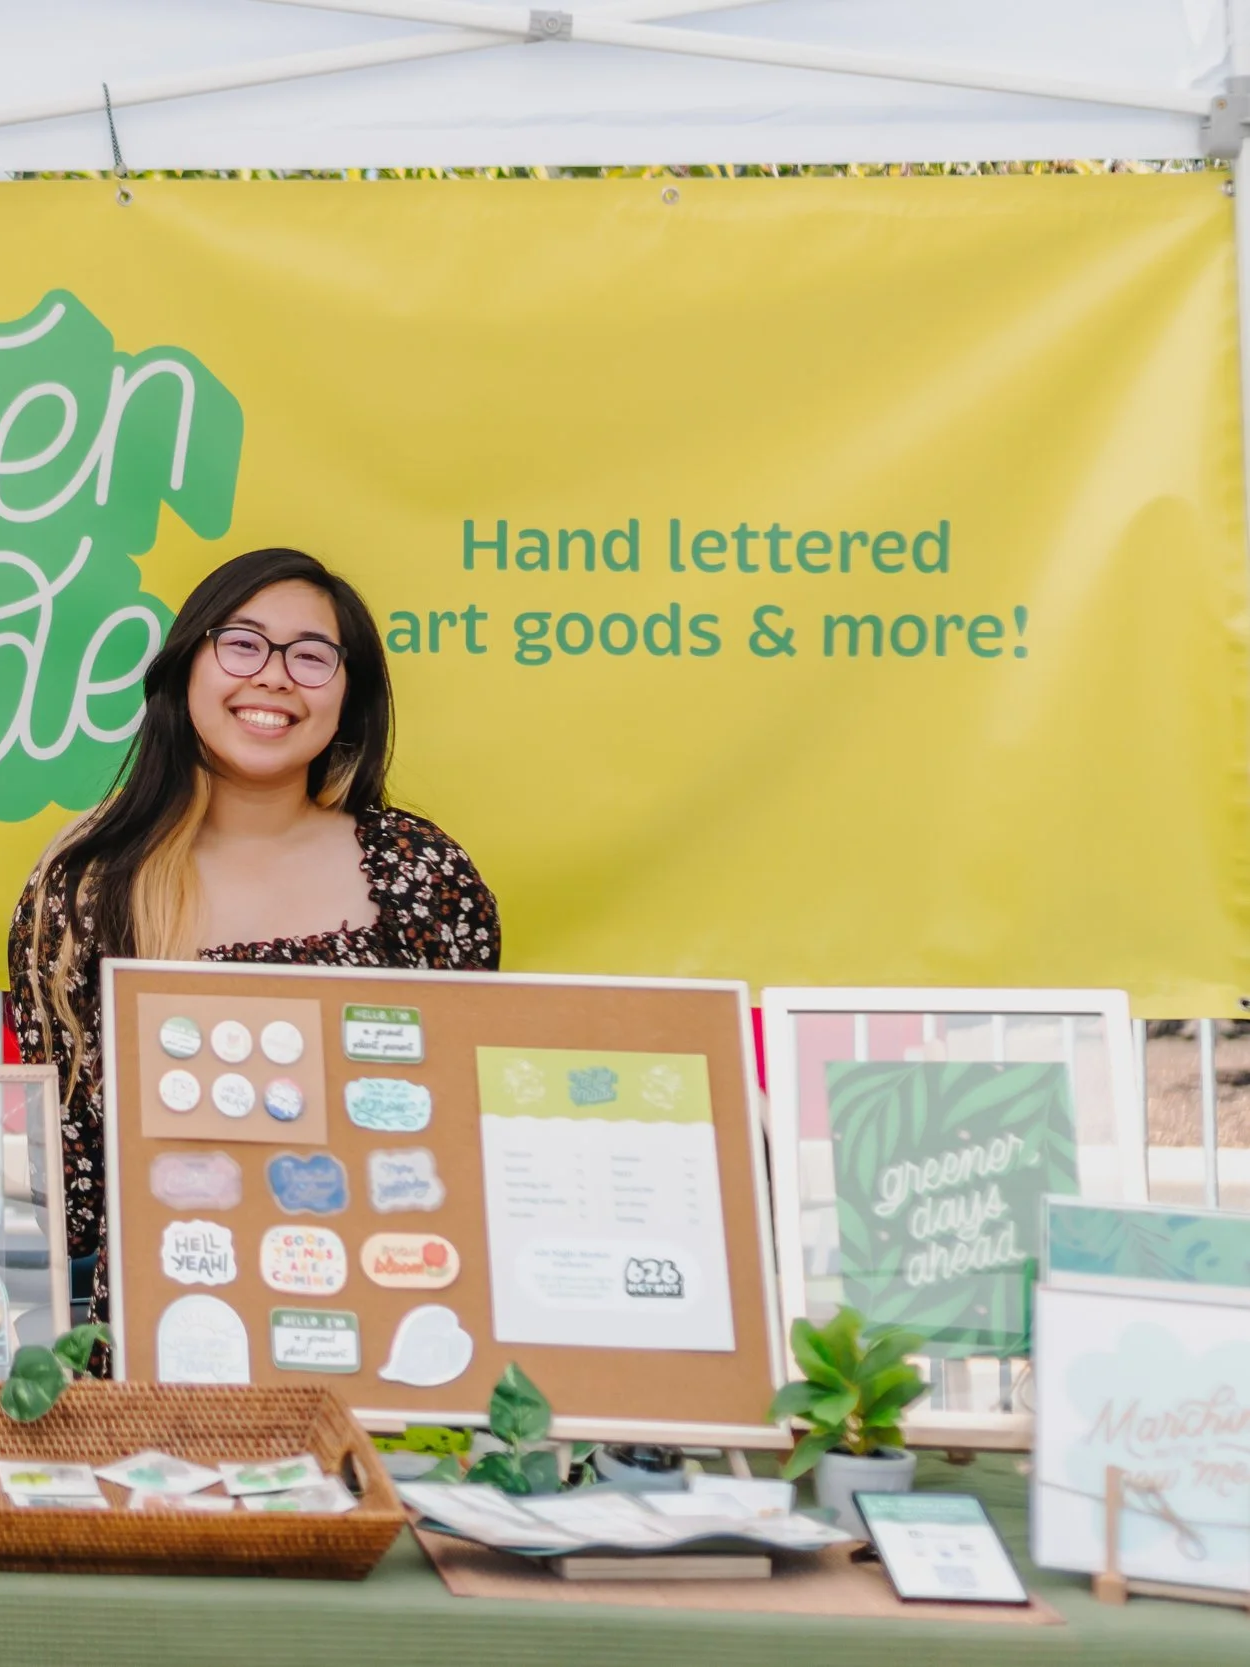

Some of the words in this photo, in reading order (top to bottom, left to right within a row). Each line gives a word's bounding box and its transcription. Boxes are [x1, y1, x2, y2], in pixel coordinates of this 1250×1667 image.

[462, 518, 640, 572] Hand
[669, 518, 951, 574] lettered
[385, 603, 489, 655] art
[513, 601, 722, 667] goods
[748, 604, 798, 658] &
[822, 605, 1029, 659] more!
[873, 1132, 1027, 1217] greener
[912, 1183, 1009, 1242] days
[175, 1232, 221, 1254] HELL
[625, 1256, 683, 1285] 626
[907, 1220, 1027, 1287] ahead
